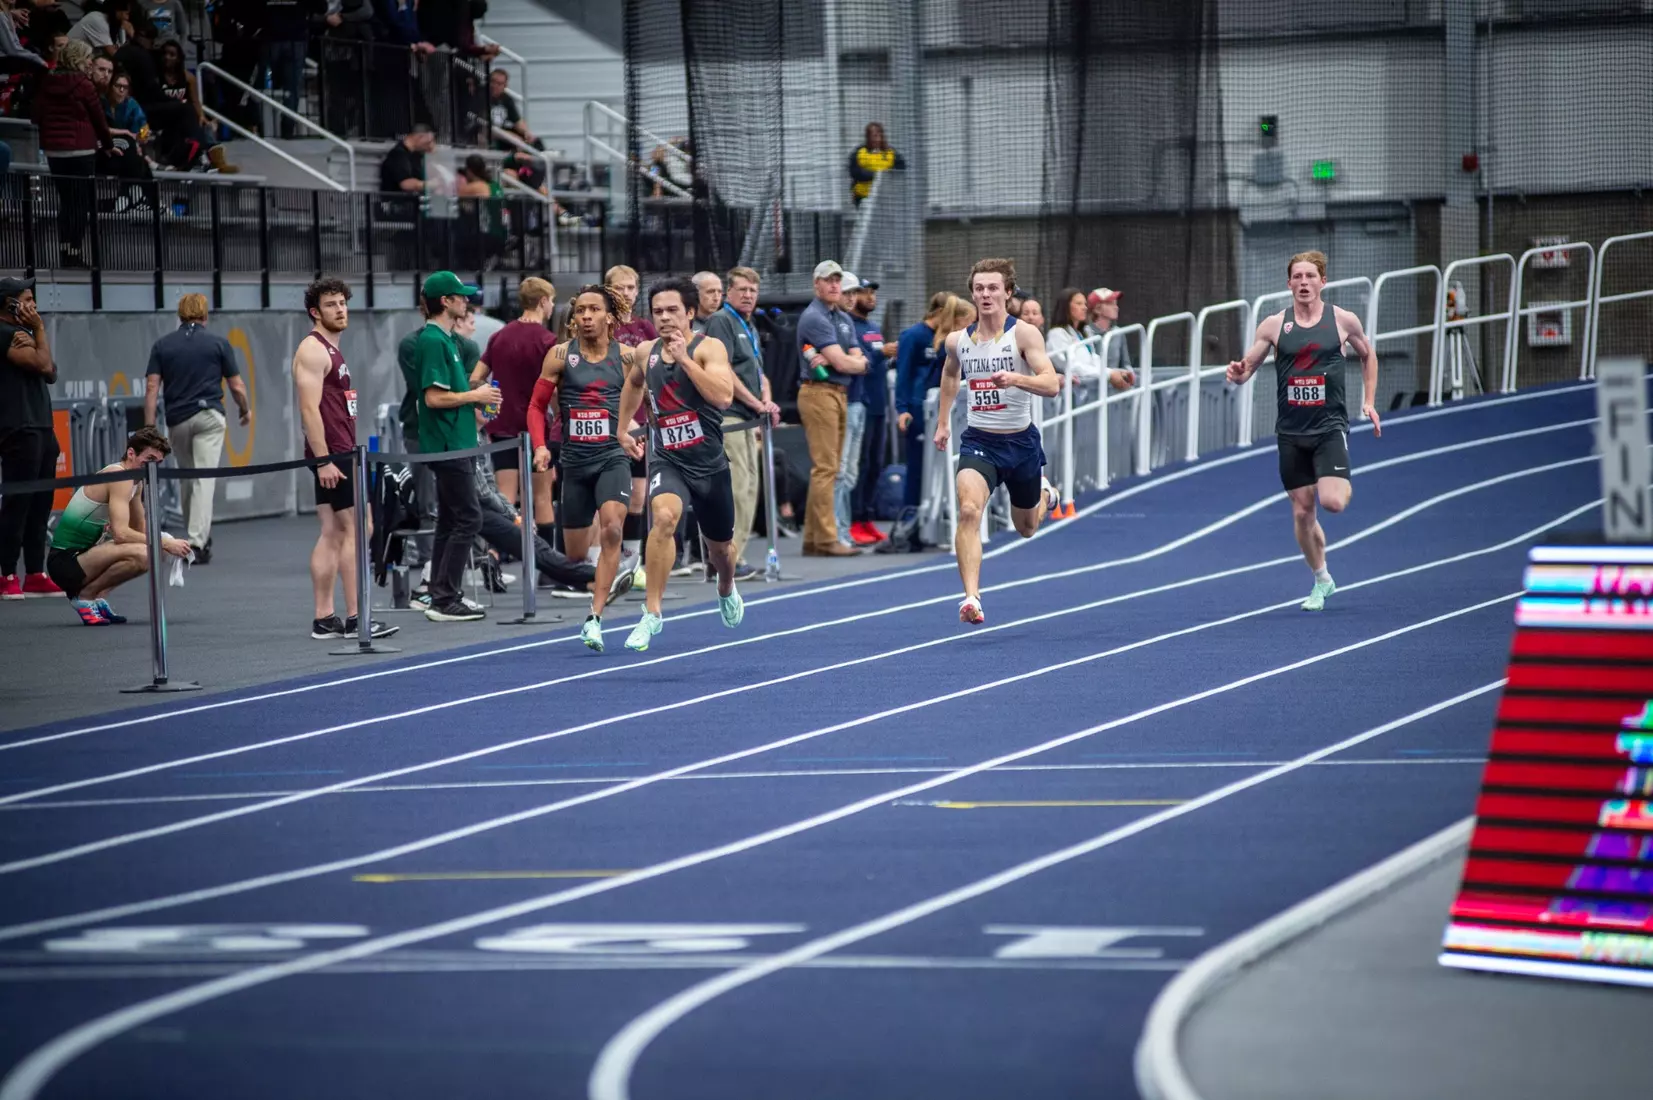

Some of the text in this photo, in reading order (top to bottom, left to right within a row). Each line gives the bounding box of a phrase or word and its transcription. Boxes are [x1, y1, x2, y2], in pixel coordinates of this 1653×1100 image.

[992, 356, 1015, 373] STATE
[974, 390, 1000, 406] 559
[1293, 386, 1320, 401] 868
[677, 415, 690, 423] OPEN
[575, 420, 603, 436] 866
[666, 423, 696, 444] 875
